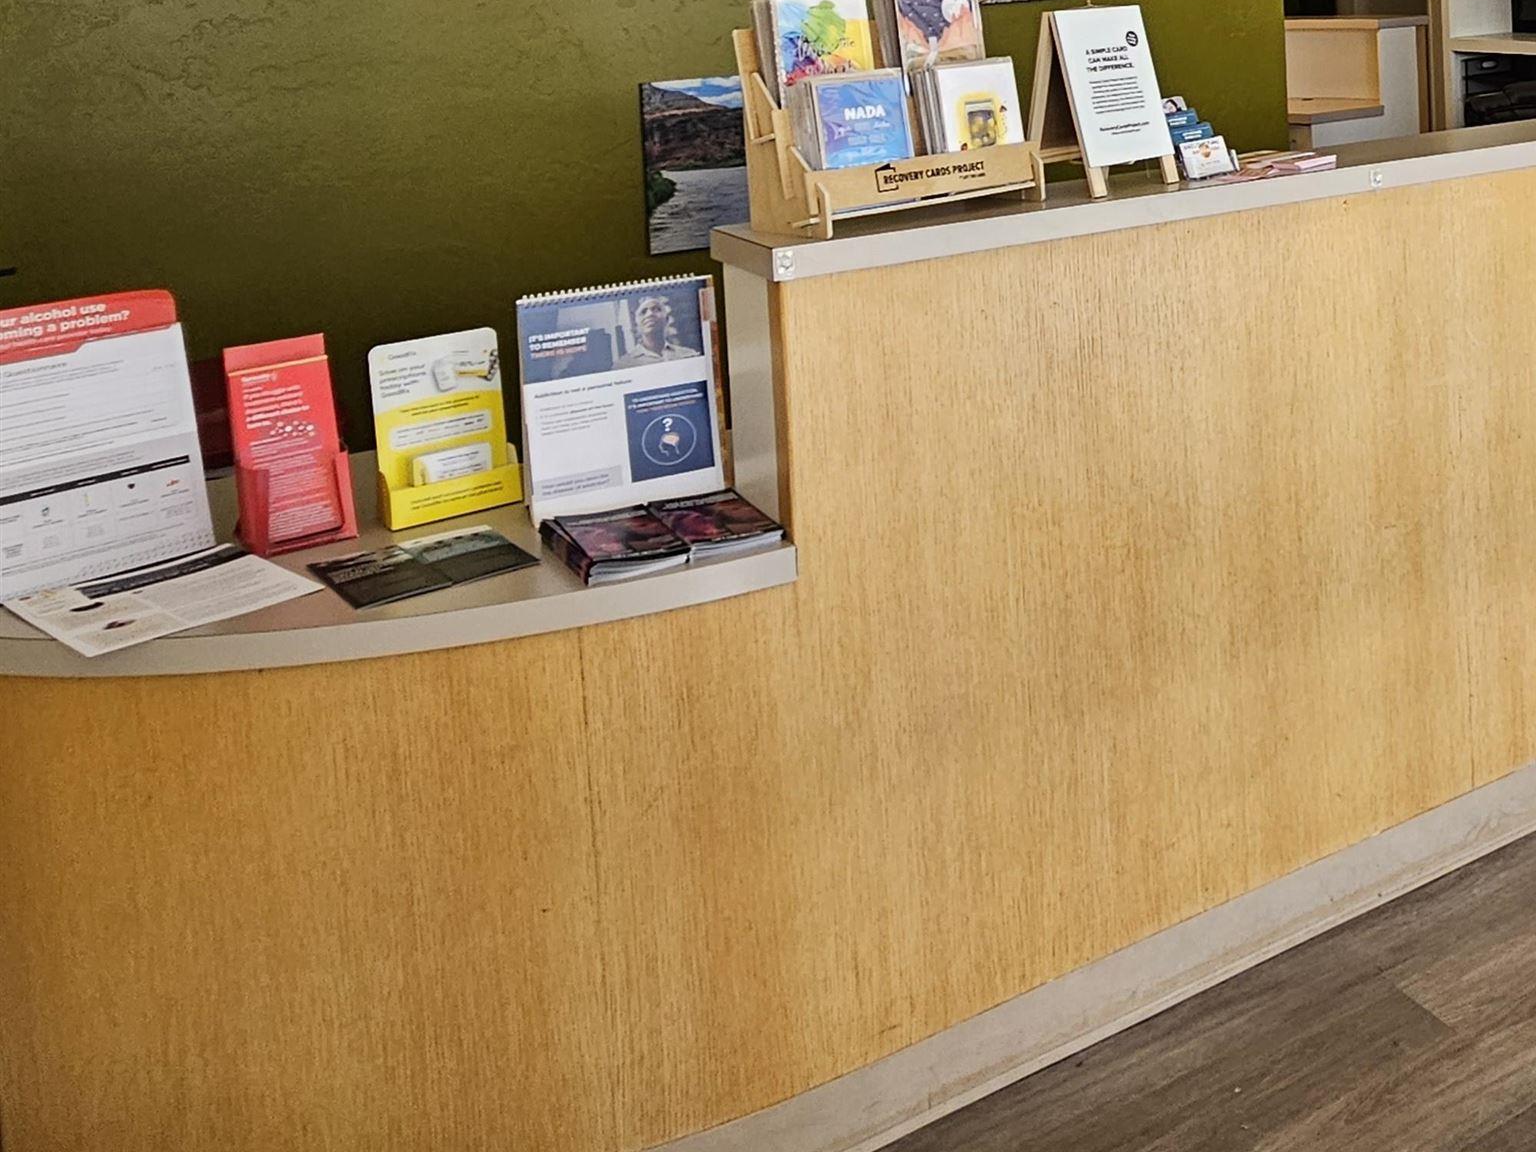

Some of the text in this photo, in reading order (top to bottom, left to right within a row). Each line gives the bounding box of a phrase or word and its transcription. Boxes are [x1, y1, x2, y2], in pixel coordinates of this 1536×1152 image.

[1091, 47, 1111, 55] SIMPLE
[1111, 45, 1128, 53] CARD
[1101, 54, 1117, 62] MAKE
[844, 104, 886, 121] NADA
[883, 170, 924, 185] RECOVERY
[925, 165, 951, 179] CARDS
[952, 160, 985, 174] PROJECT
[20, 305, 77, 325] alcohol
[80, 303, 107, 314] use
[47, 323, 57, 333] a
[60, 310, 131, 333] problem?
